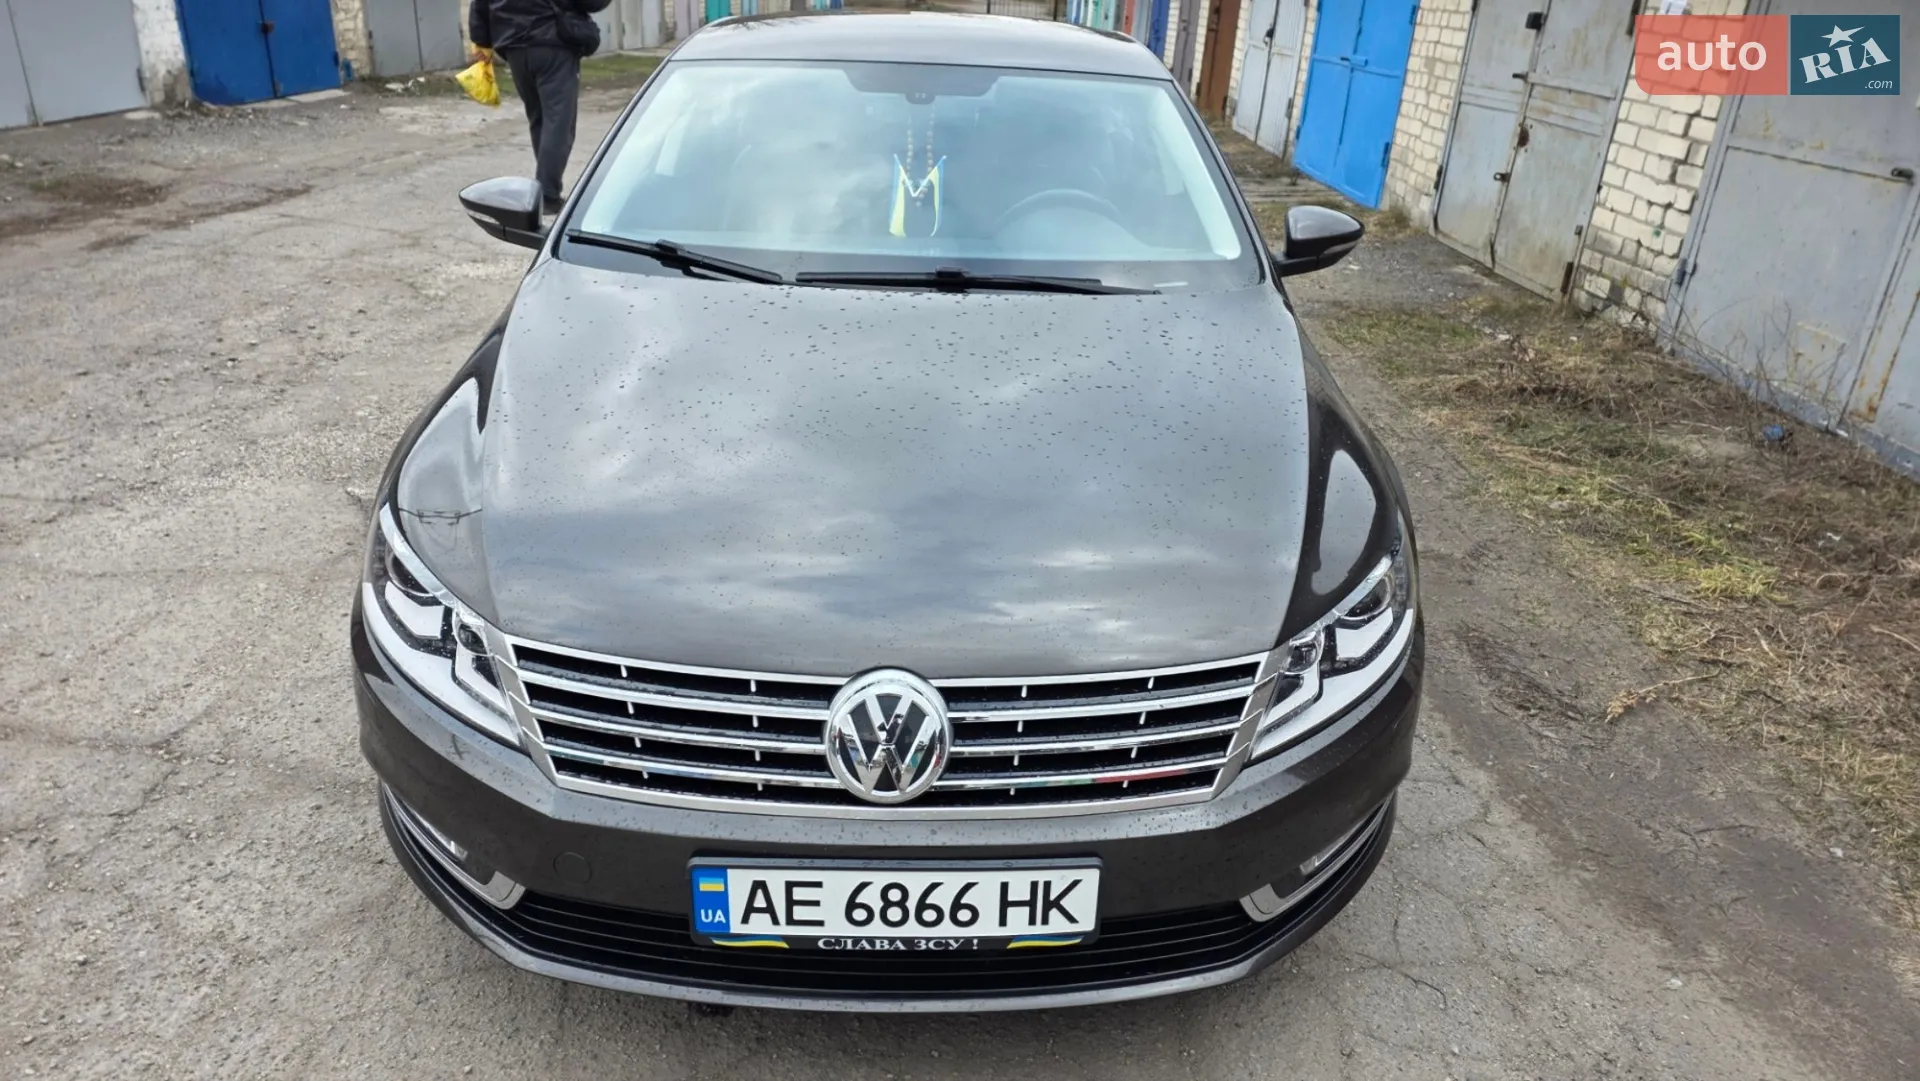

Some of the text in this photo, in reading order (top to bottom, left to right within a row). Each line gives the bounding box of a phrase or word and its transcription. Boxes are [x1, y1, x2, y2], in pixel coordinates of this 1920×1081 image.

[740, 878, 1084, 928] AE 6866 HK
[700, 908, 727, 924] UA
[817, 937, 908, 951] СЛАВА
[914, 938, 965, 951] ЗСУ
